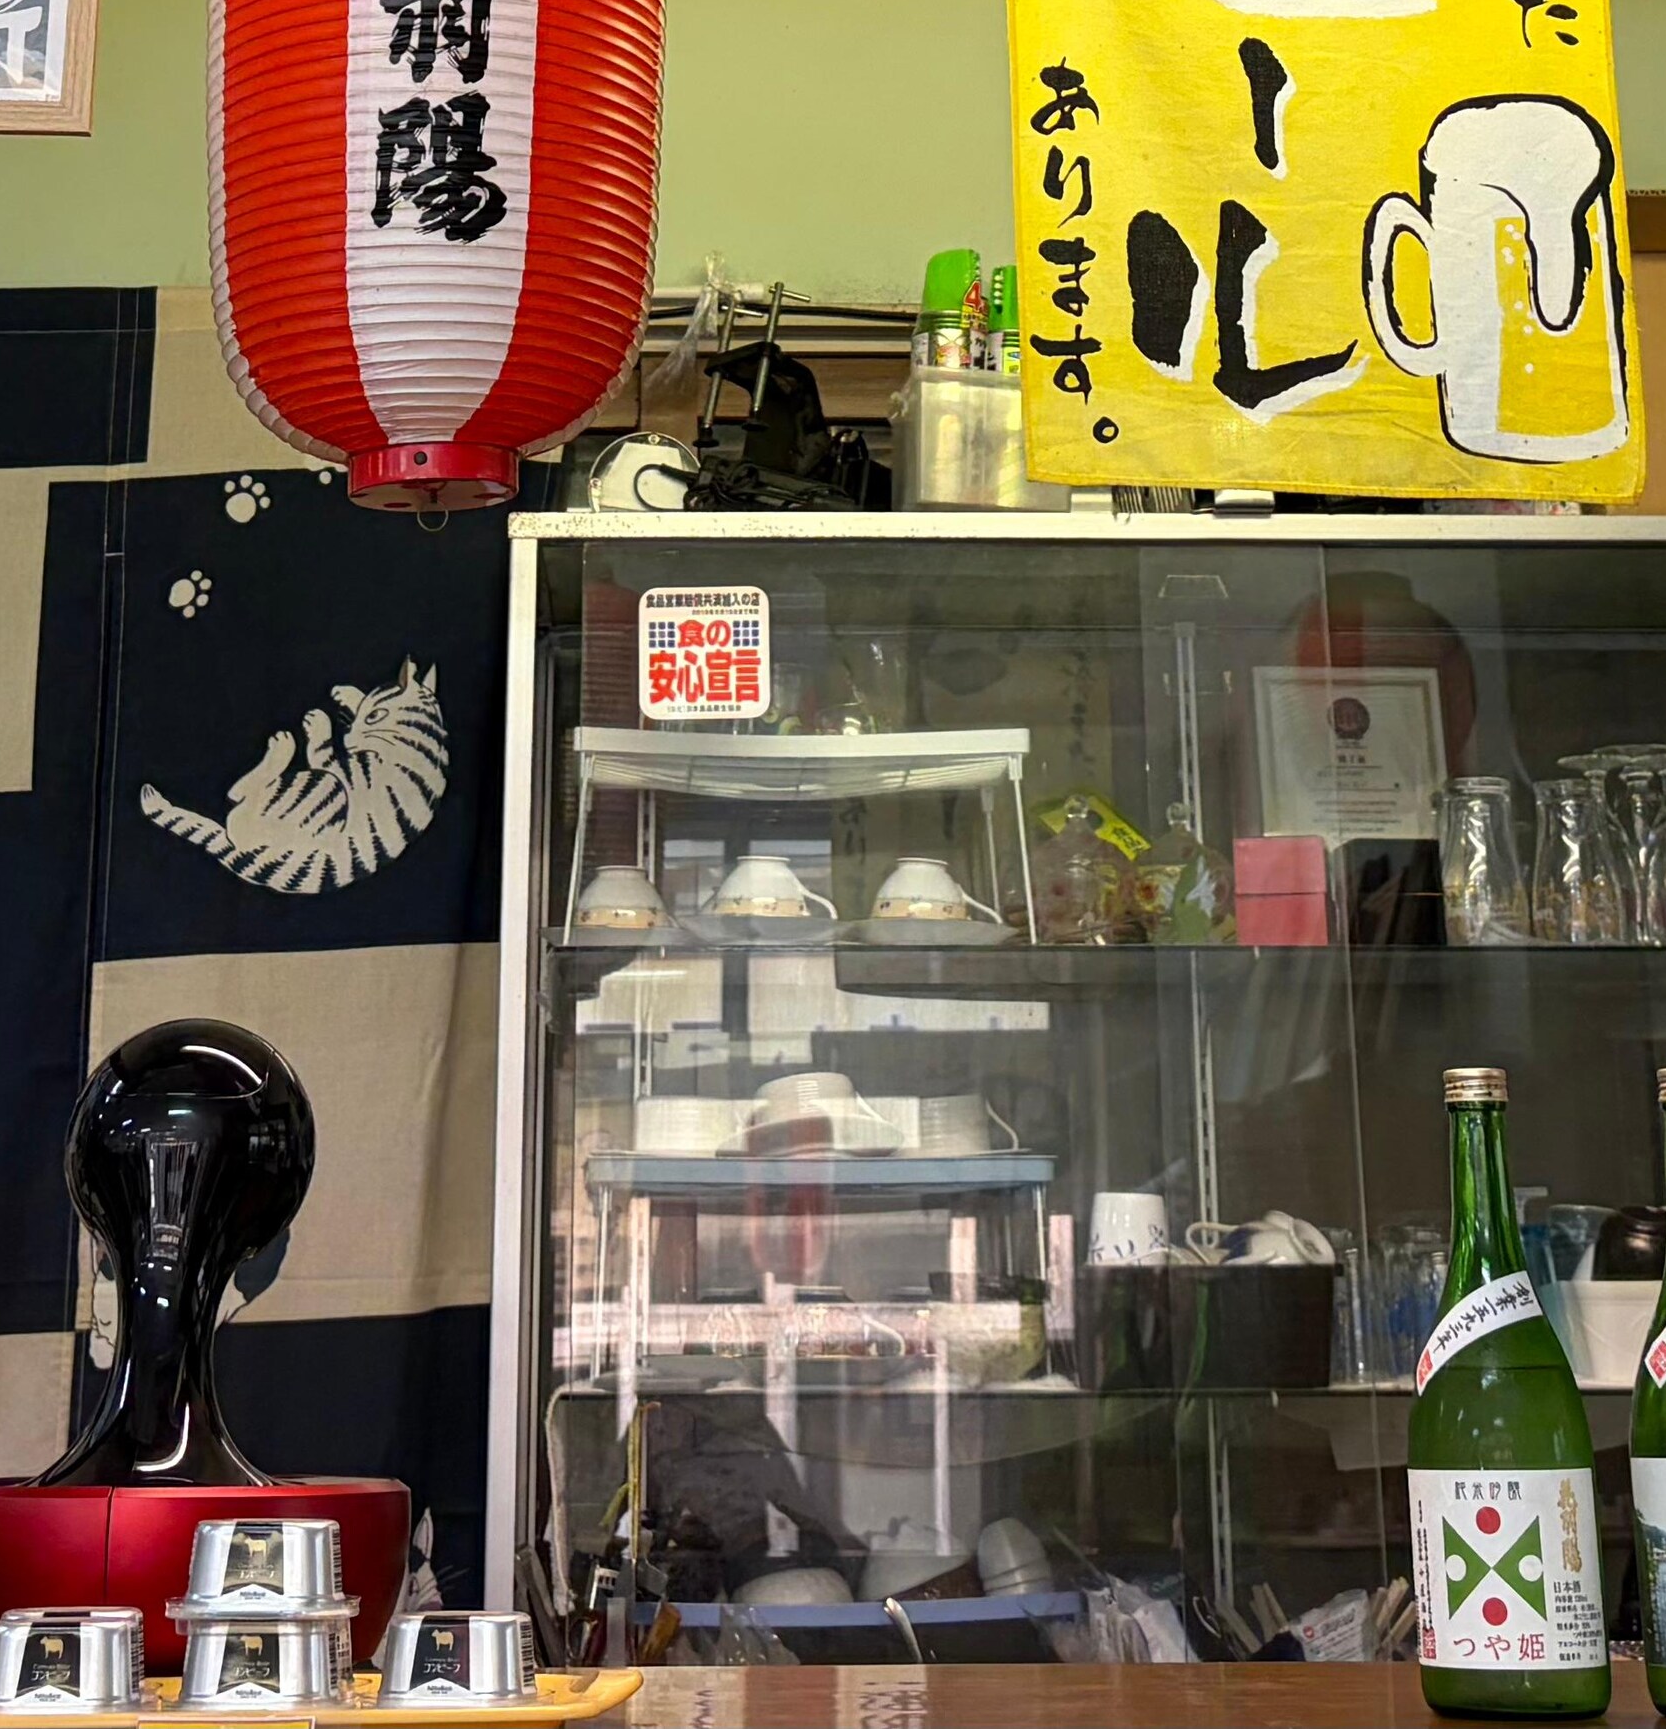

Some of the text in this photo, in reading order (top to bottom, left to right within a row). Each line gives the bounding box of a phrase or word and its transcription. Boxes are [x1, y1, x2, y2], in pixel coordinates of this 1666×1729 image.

[1030, 55, 1120, 446] あります。
[677, 619, 731, 648] 食の
[648, 649, 761, 704] 安心宣言
[1453, 1632, 1546, 1662] つや姫
